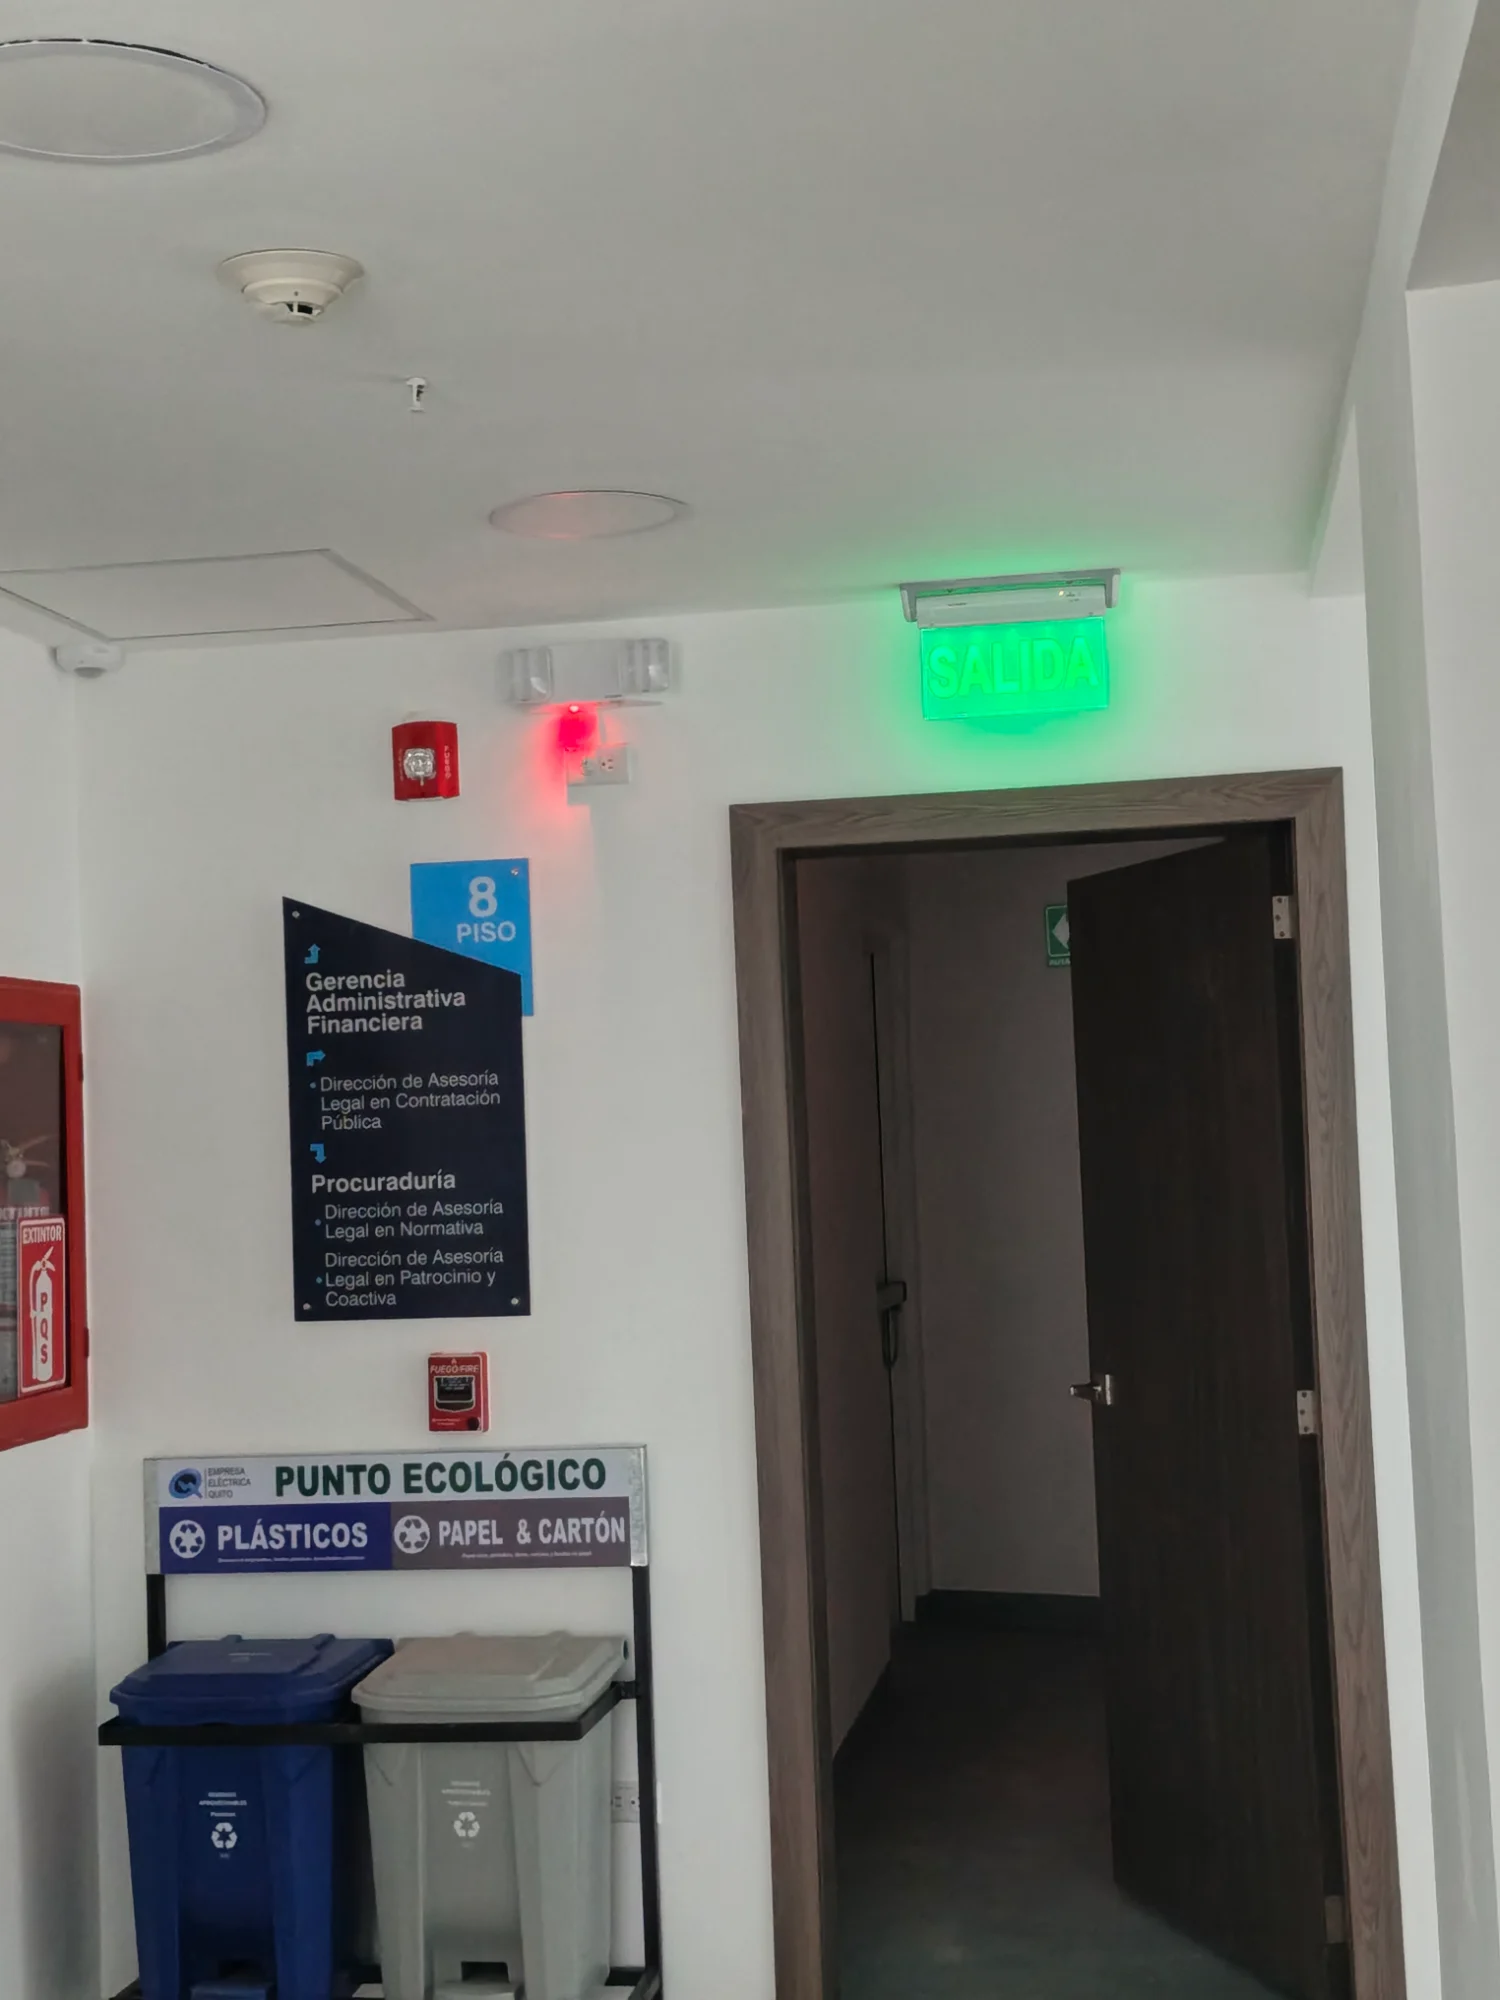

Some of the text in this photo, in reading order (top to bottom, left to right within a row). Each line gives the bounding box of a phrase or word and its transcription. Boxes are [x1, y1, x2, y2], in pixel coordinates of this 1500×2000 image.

[928, 636, 1100, 699] SALIDA
[469, 876, 497, 918] 8
[456, 921, 516, 943] PISO
[306, 969, 405, 992] Gerencia
[306, 988, 466, 1013] Administrativa
[307, 1013, 423, 1034] Financiera
[321, 1070, 499, 1092] Dirección de Asesoría
[321, 1090, 501, 1114] Legal en Contratación
[322, 1114, 382, 1131] Pública
[311, 1169, 456, 1193] Procuraduría
[325, 1199, 504, 1219] Dirección de Asesoría
[22, 1224, 63, 1245] EXTINTOR
[325, 1220, 484, 1242] Legal en Normativa
[325, 1247, 504, 1267] Dirección de Asesoría
[325, 1269, 497, 1290] Legal en Patrocinio y
[325, 1291, 397, 1307] Coactiva
[207, 1467, 246, 1477] EMPRESA
[207, 1477, 252, 1488] ELÉCTRICA
[275, 1453, 606, 1497] PUNTO ECOLÓGICO
[208, 1489, 234, 1499] QUITO
[217, 1519, 368, 1551] PLÁSTICOS
[438, 1510, 626, 1546] PAPEL & CARTÓN
